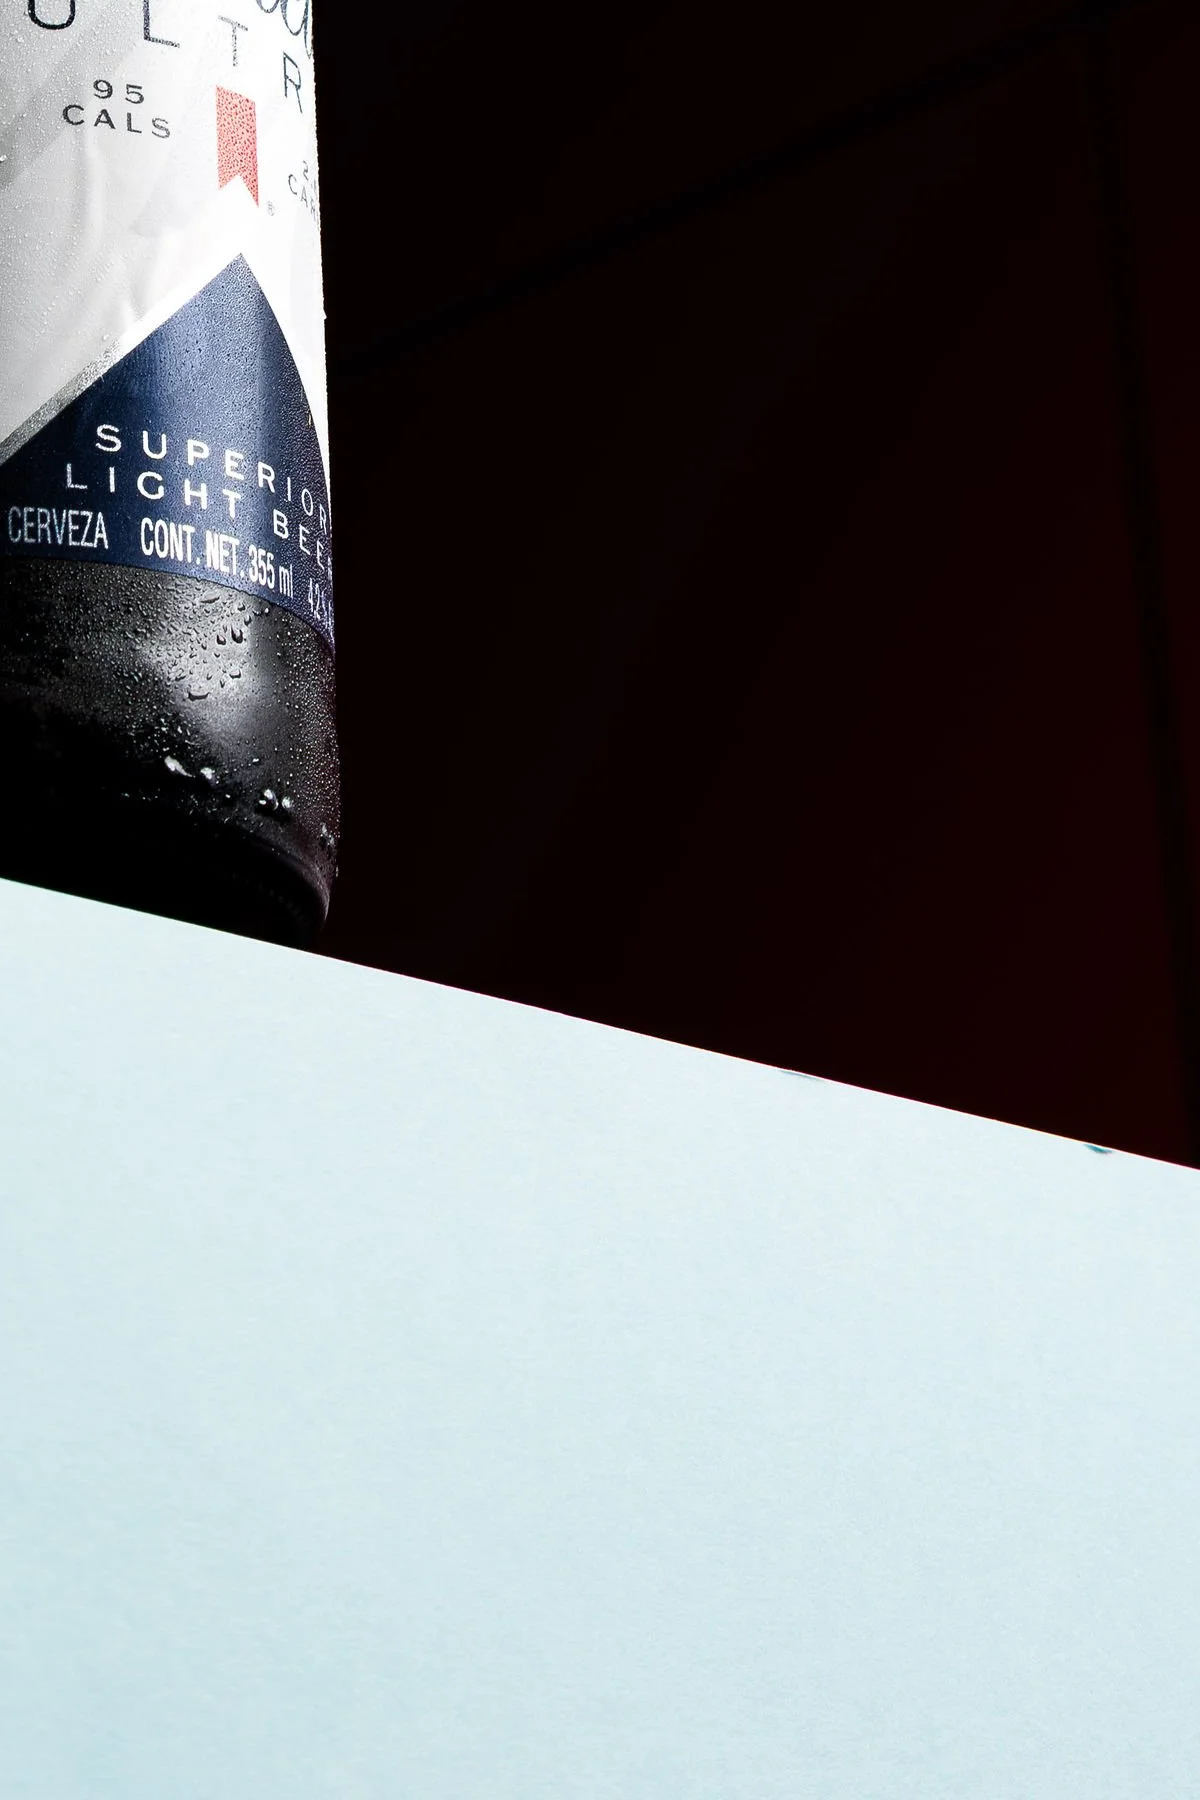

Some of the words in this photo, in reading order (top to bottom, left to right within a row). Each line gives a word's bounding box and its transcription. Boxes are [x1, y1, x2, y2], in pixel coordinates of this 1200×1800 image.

[62, 103, 171, 139] CALS
[93, 79, 145, 105] 95
[66, 462, 241, 520] LIGHT
[95, 423, 328, 535] SUPERIOR
[7, 506, 109, 550] CERVEZA
[140, 517, 200, 565] CONT.
[204, 529, 245, 578] NET.
[248, 544, 276, 590] 355
[278, 563, 294, 600] ml
